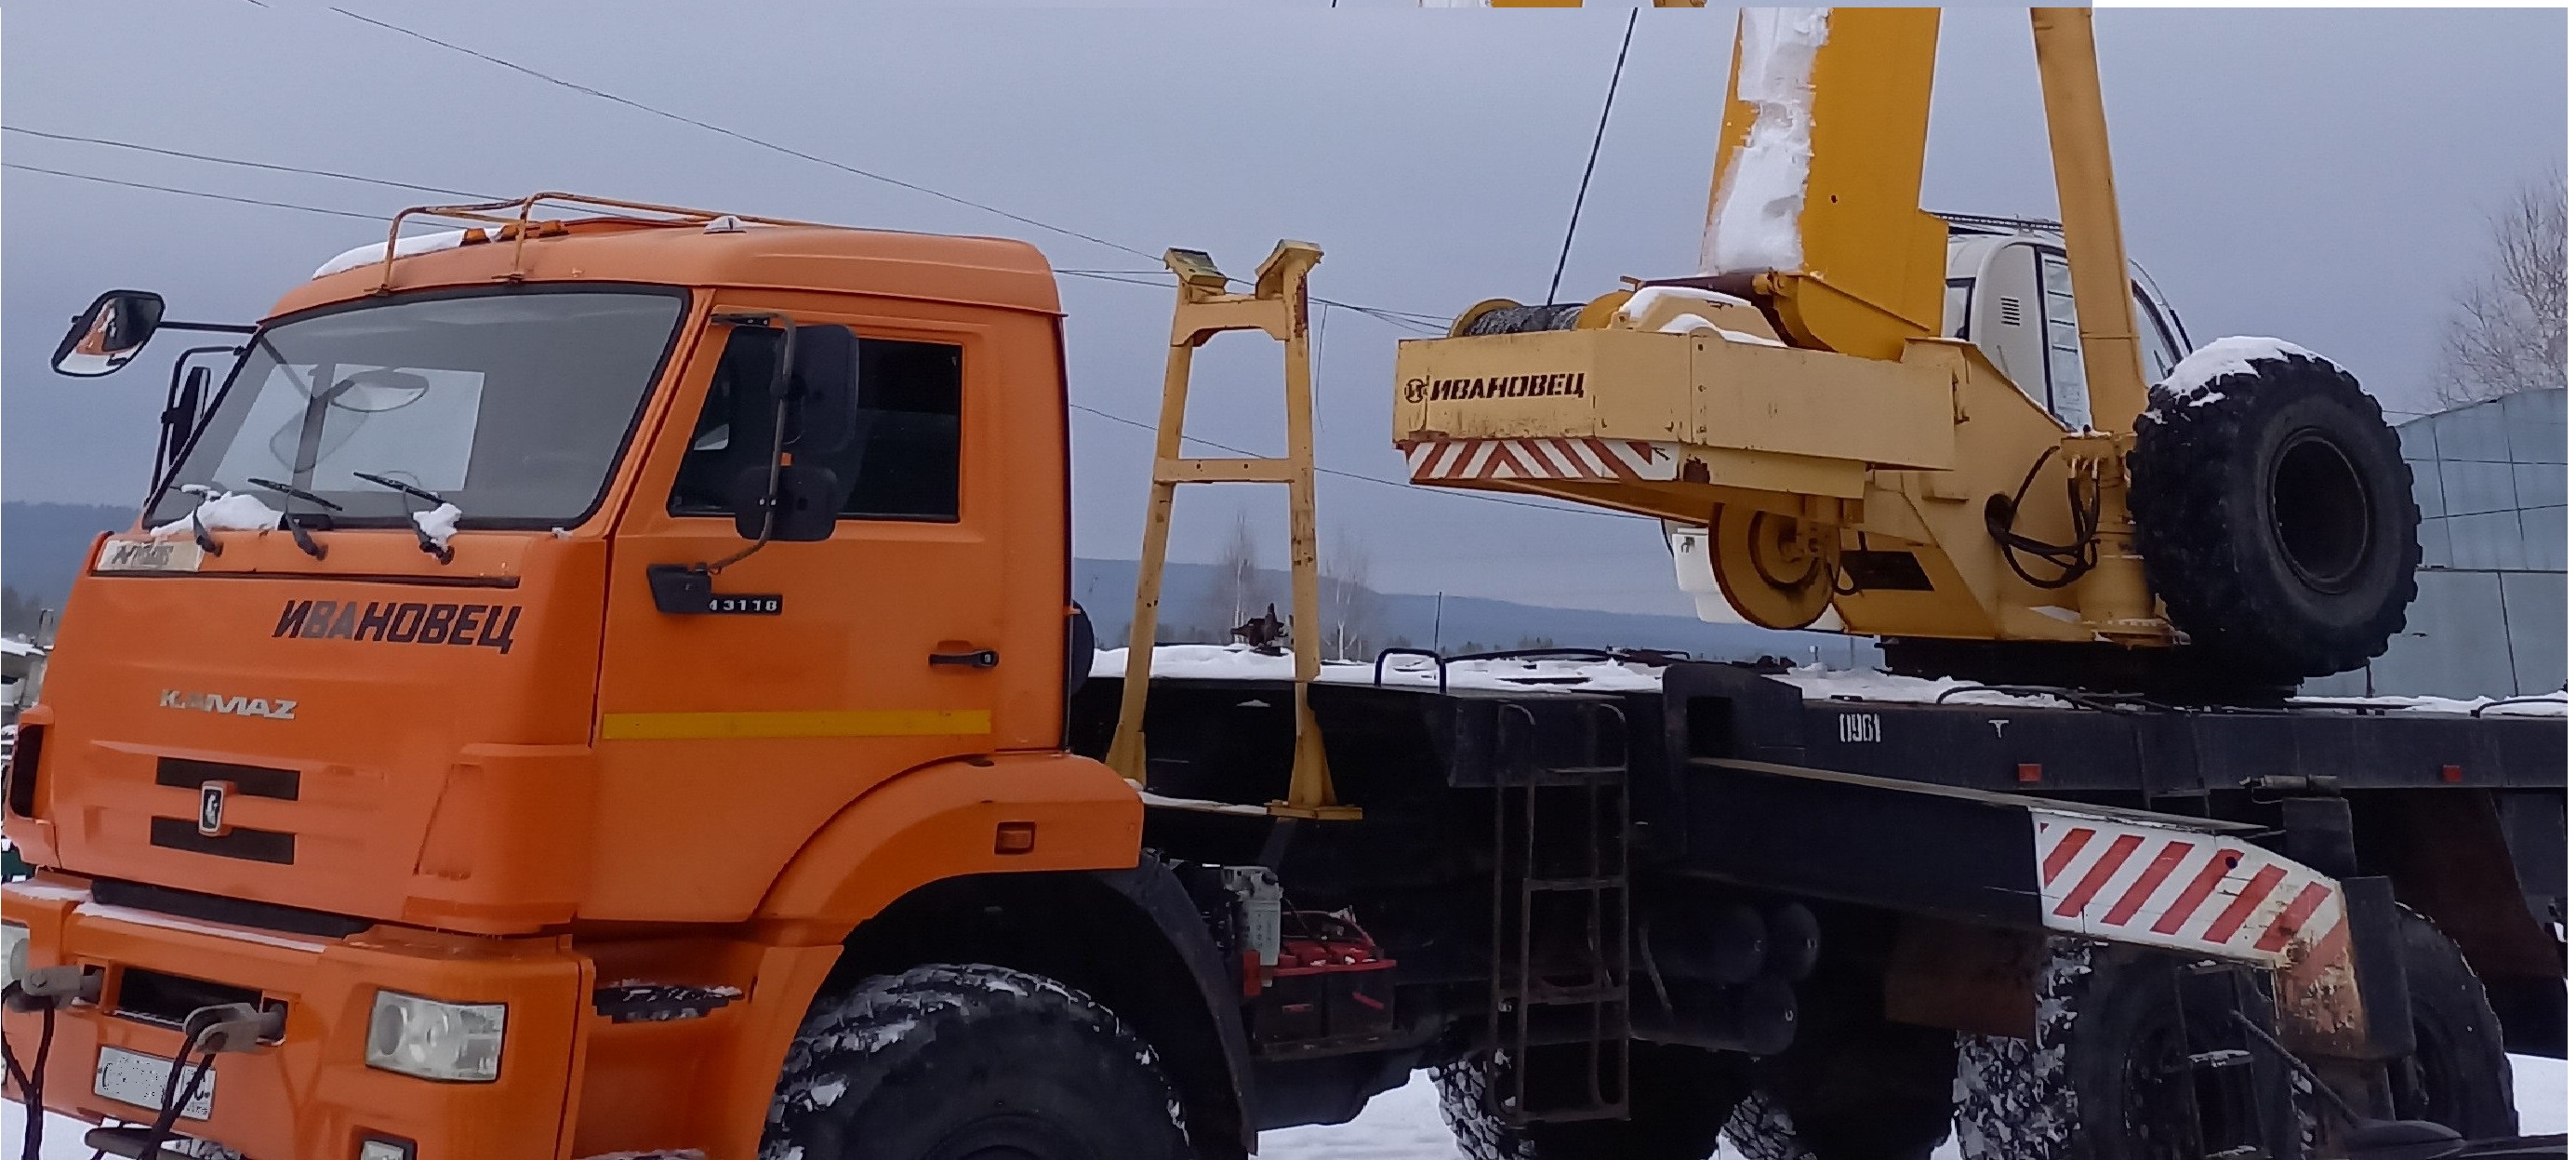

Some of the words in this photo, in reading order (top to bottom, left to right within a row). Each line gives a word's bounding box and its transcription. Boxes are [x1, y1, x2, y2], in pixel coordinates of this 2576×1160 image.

[1430, 373, 1585, 401] ИВАНОВЕЦ
[710, 600, 777, 611] 43118
[272, 600, 522, 655] ИВАНОВЕЦ
